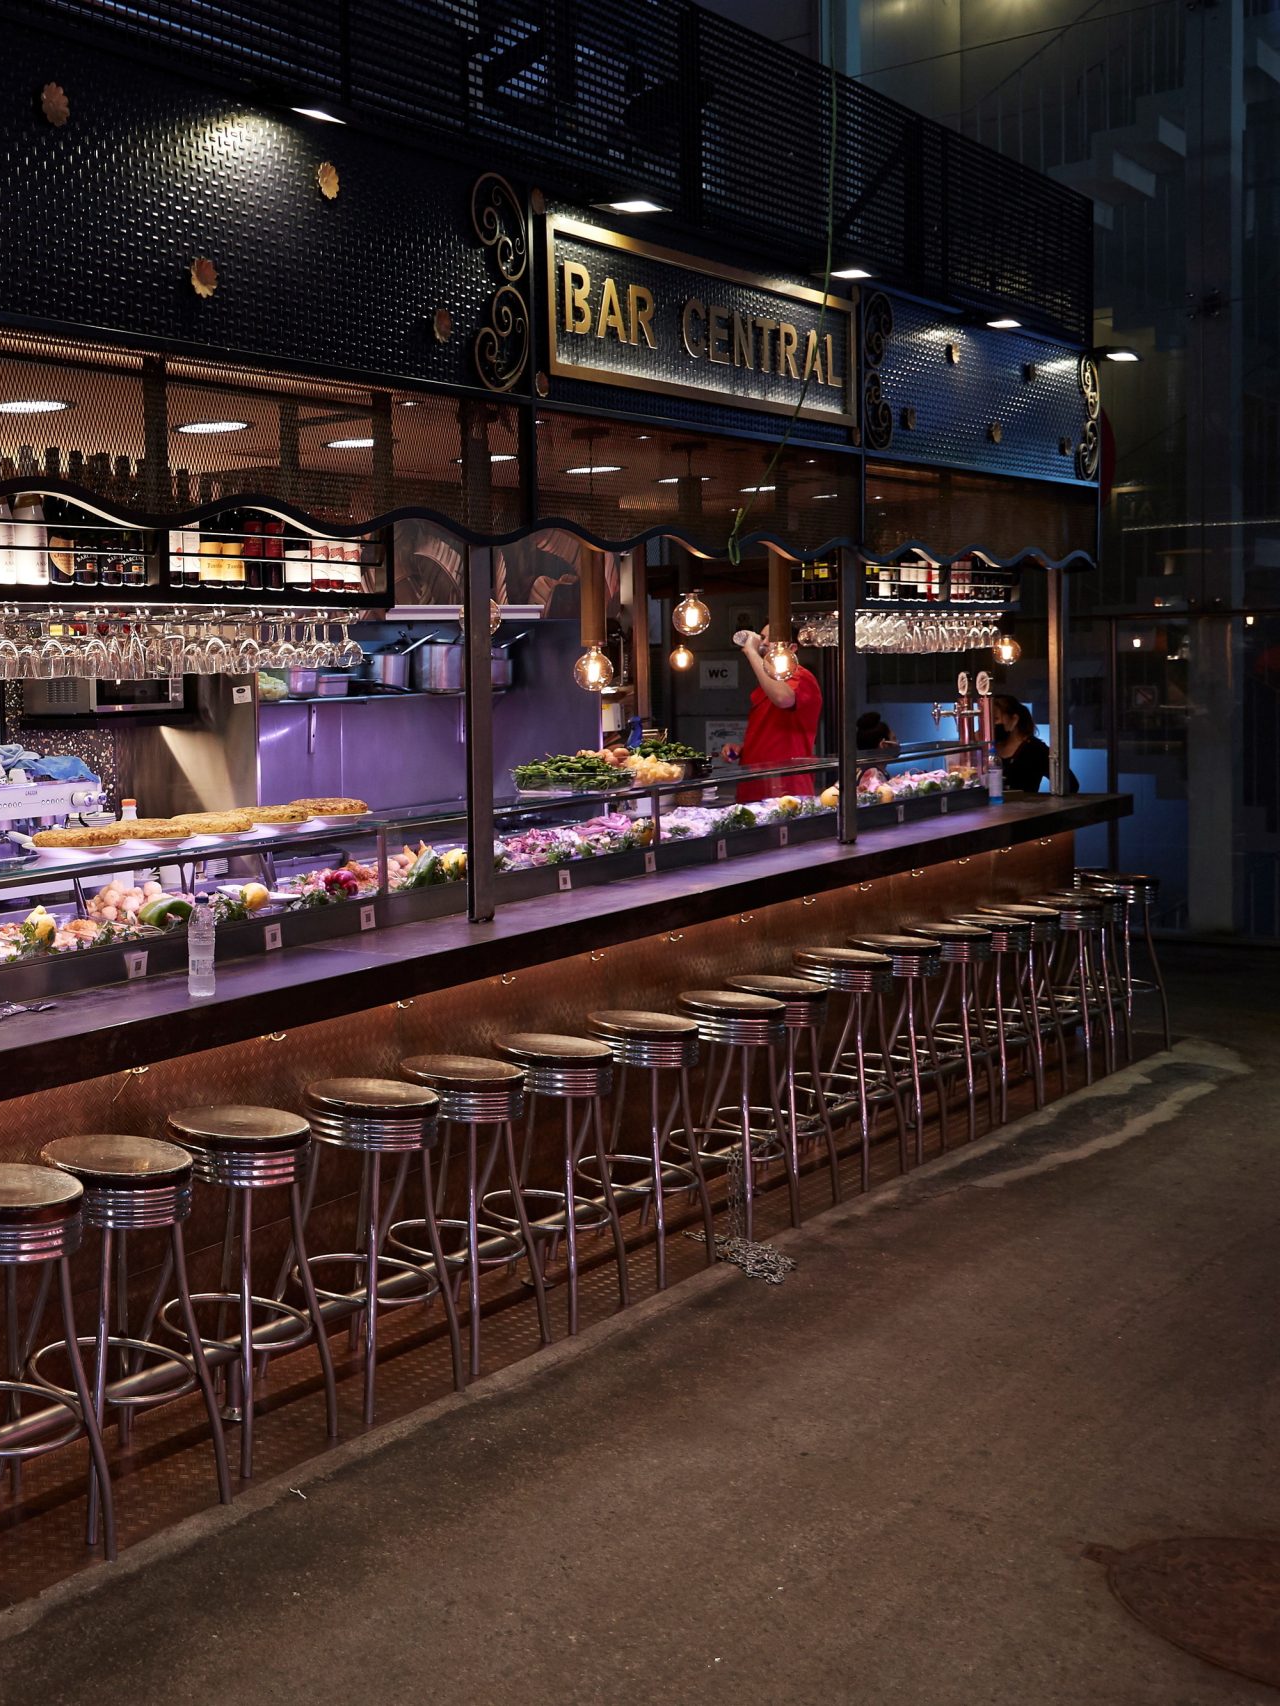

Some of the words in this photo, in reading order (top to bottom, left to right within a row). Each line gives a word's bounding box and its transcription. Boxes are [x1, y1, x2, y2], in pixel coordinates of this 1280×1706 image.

[563, 260, 658, 350] BAR
[682, 298, 844, 388] CENTRAL
[708, 669, 729, 679] WC
